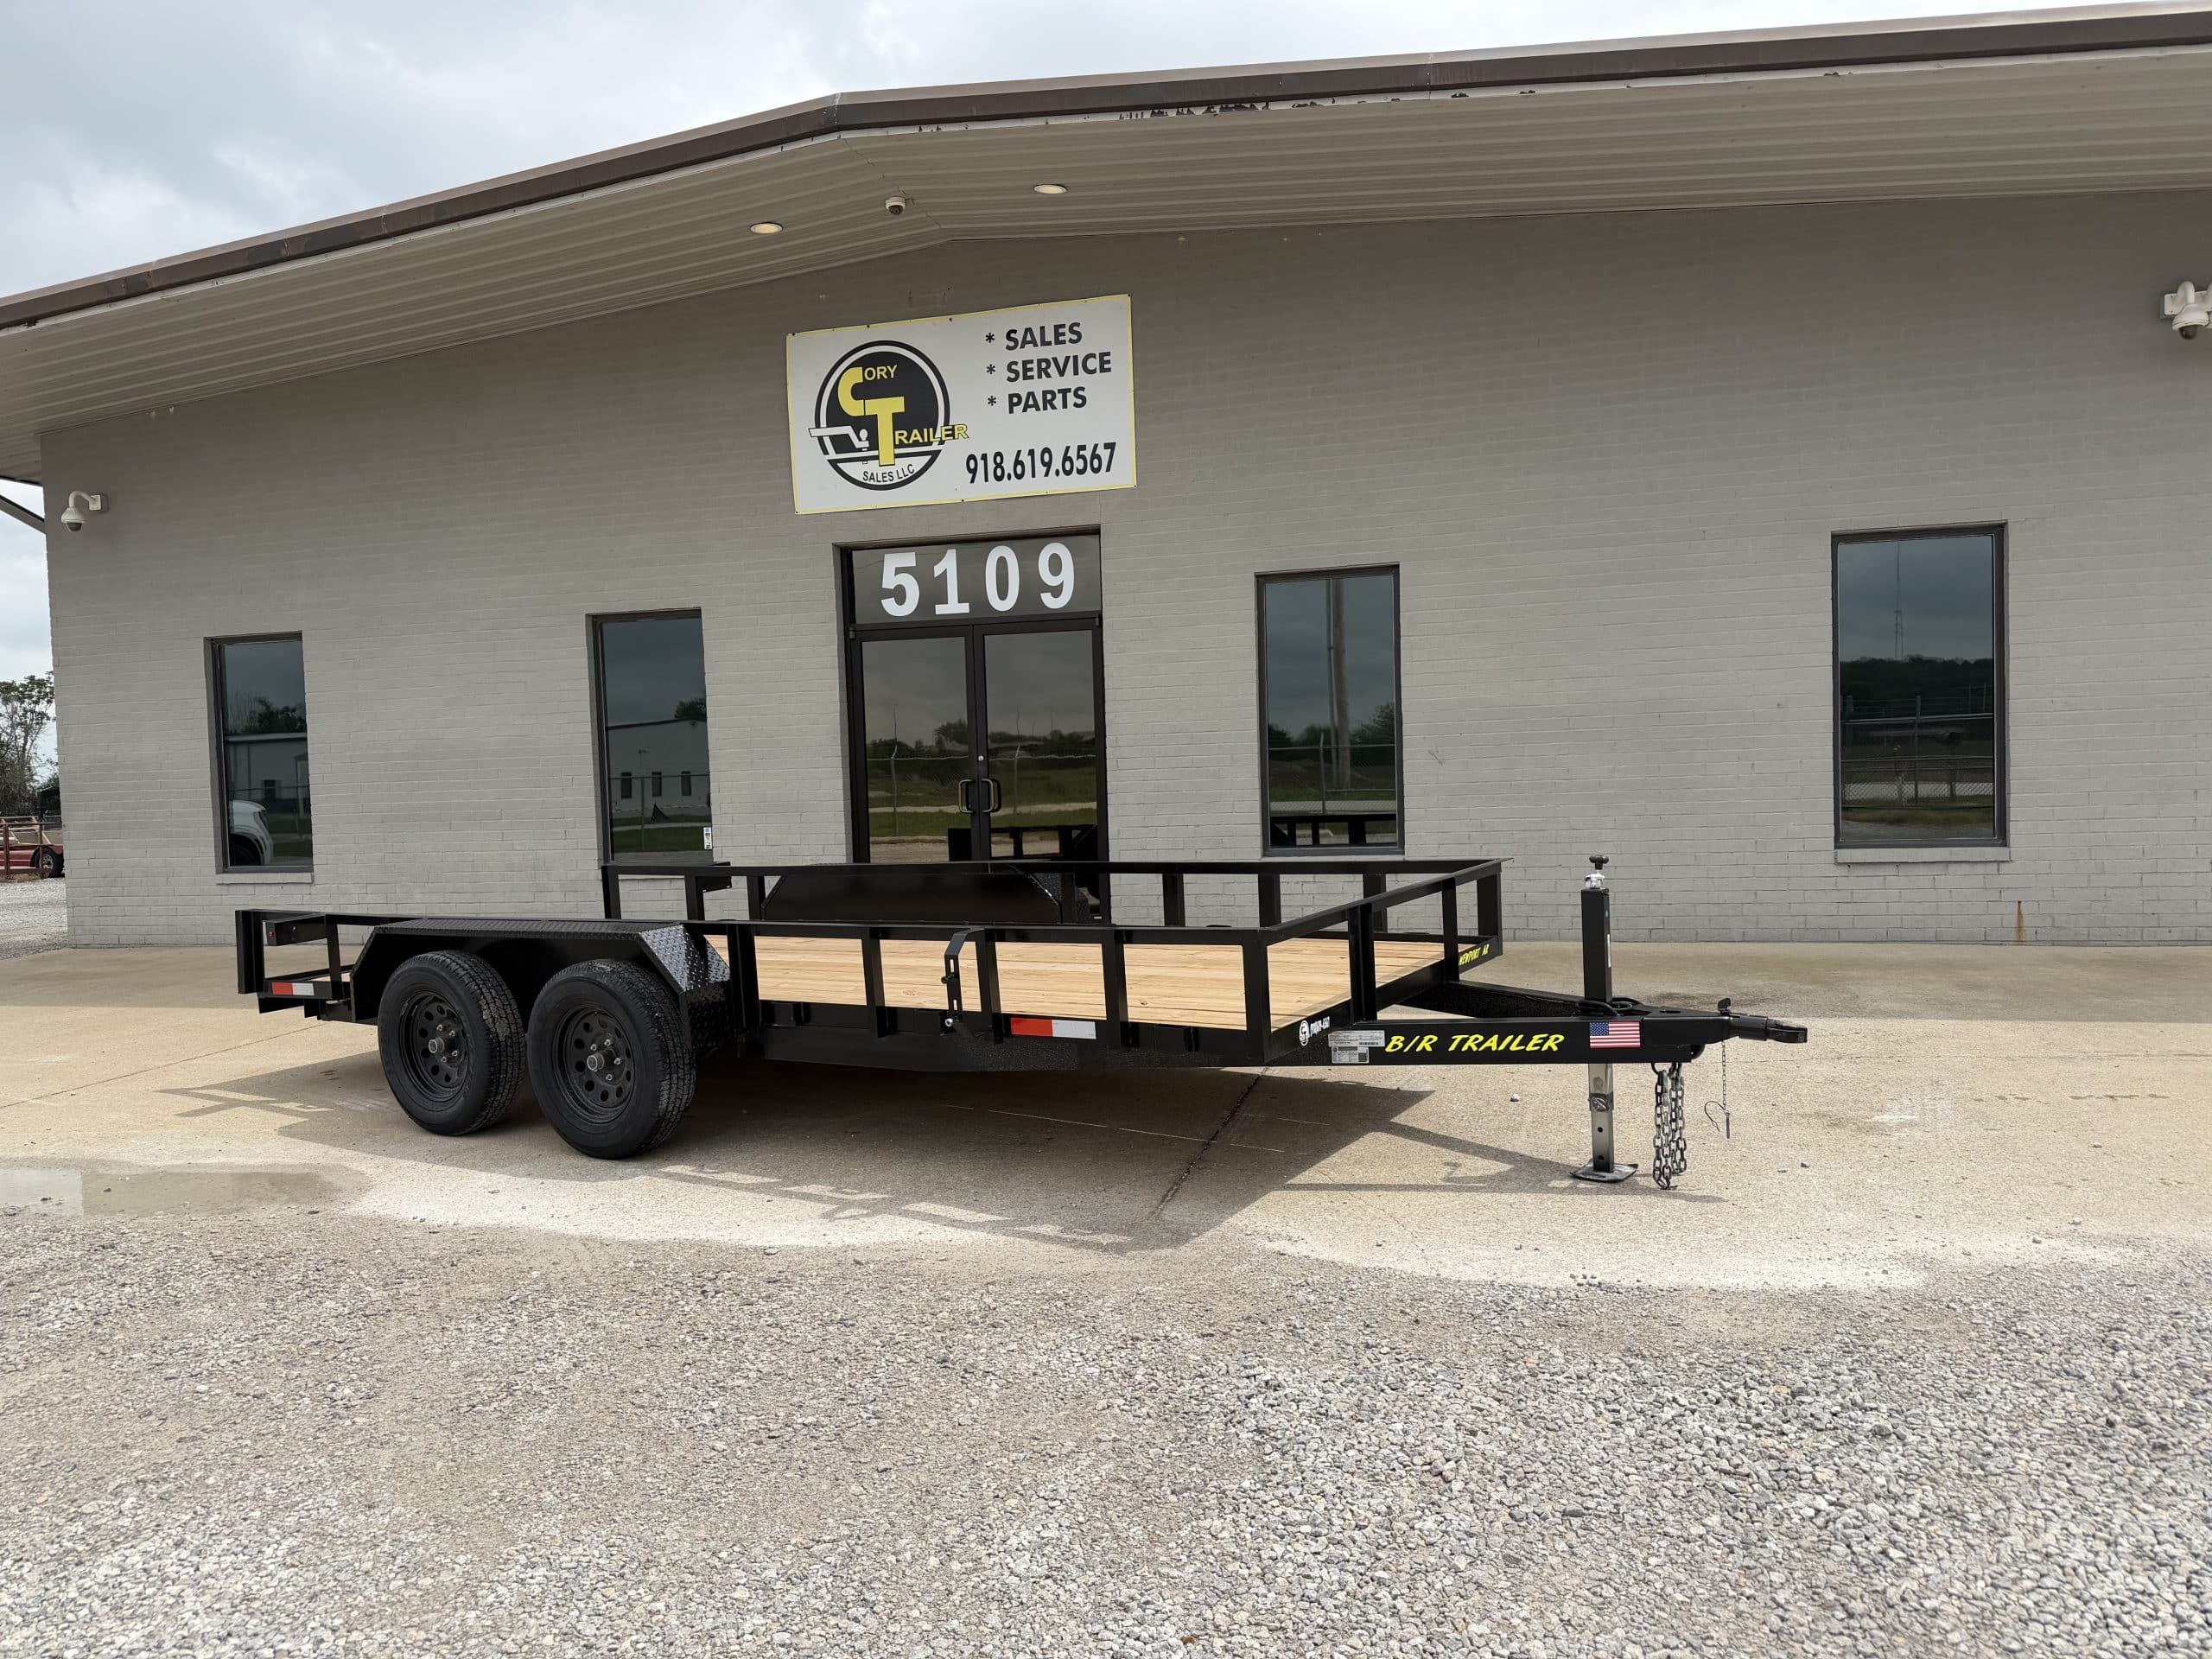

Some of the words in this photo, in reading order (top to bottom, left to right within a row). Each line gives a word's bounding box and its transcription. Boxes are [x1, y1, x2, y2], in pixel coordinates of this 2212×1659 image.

[1005, 321, 1083, 351] SALES
[1006, 351, 1112, 383] SERVICE
[1007, 386, 1087, 414] PARTS
[862, 471, 894, 483] SALES
[895, 463, 916, 479] LLC
[965, 442, 1116, 484] 918.619.6567
[880, 542, 1075, 617] 5109
[1384, 1034, 1439, 1052] B/R
[1447, 1033, 1565, 1052] TRAILER
